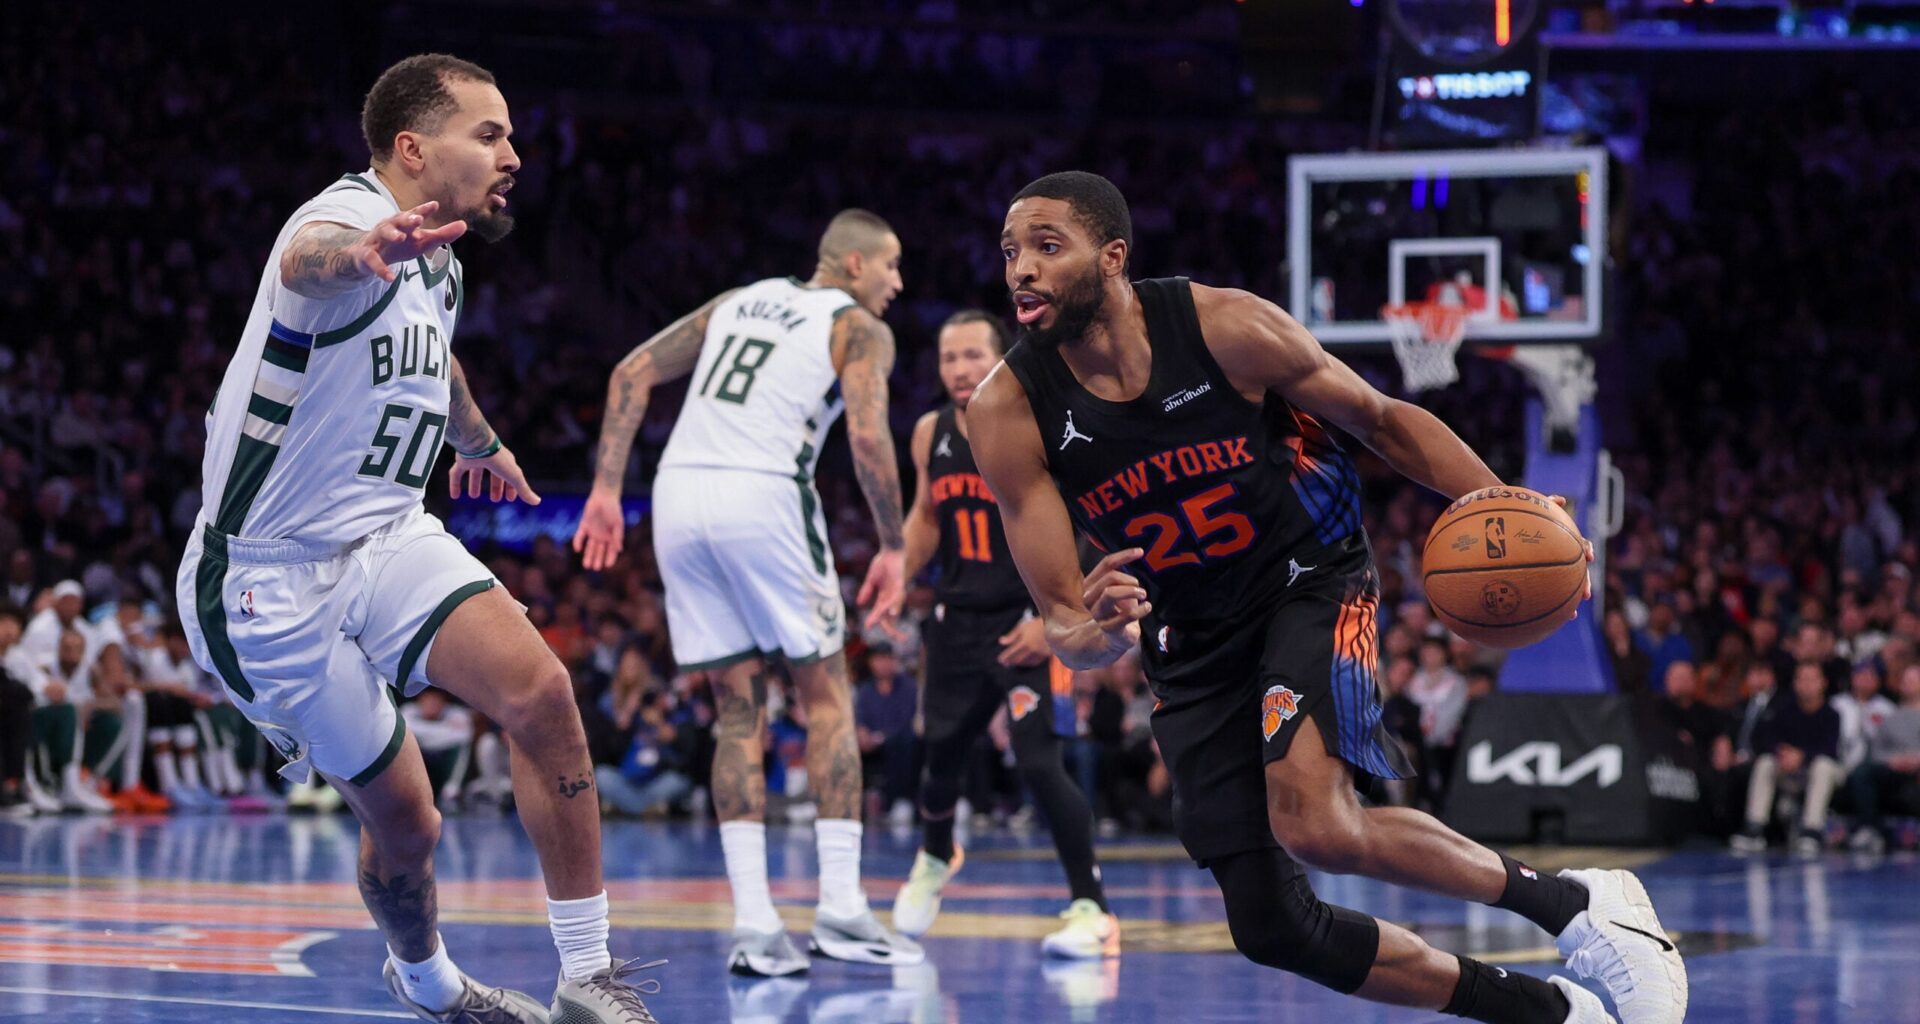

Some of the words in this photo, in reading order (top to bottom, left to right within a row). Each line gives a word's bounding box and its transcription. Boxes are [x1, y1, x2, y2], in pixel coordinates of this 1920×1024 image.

[1433, 70, 1531, 99] TISSOT
[736, 300, 807, 334] KUZMA
[700, 335, 776, 405] 18
[1165, 398, 1184, 412] abu
[1183, 381, 1211, 402] dhabi
[357, 403, 448, 490] 50
[1077, 460, 1150, 520] NEW
[1149, 436, 1256, 484] YORK
[954, 507, 993, 562] 11
[1123, 482, 1257, 573] 25
[1467, 740, 1623, 788] KIA
